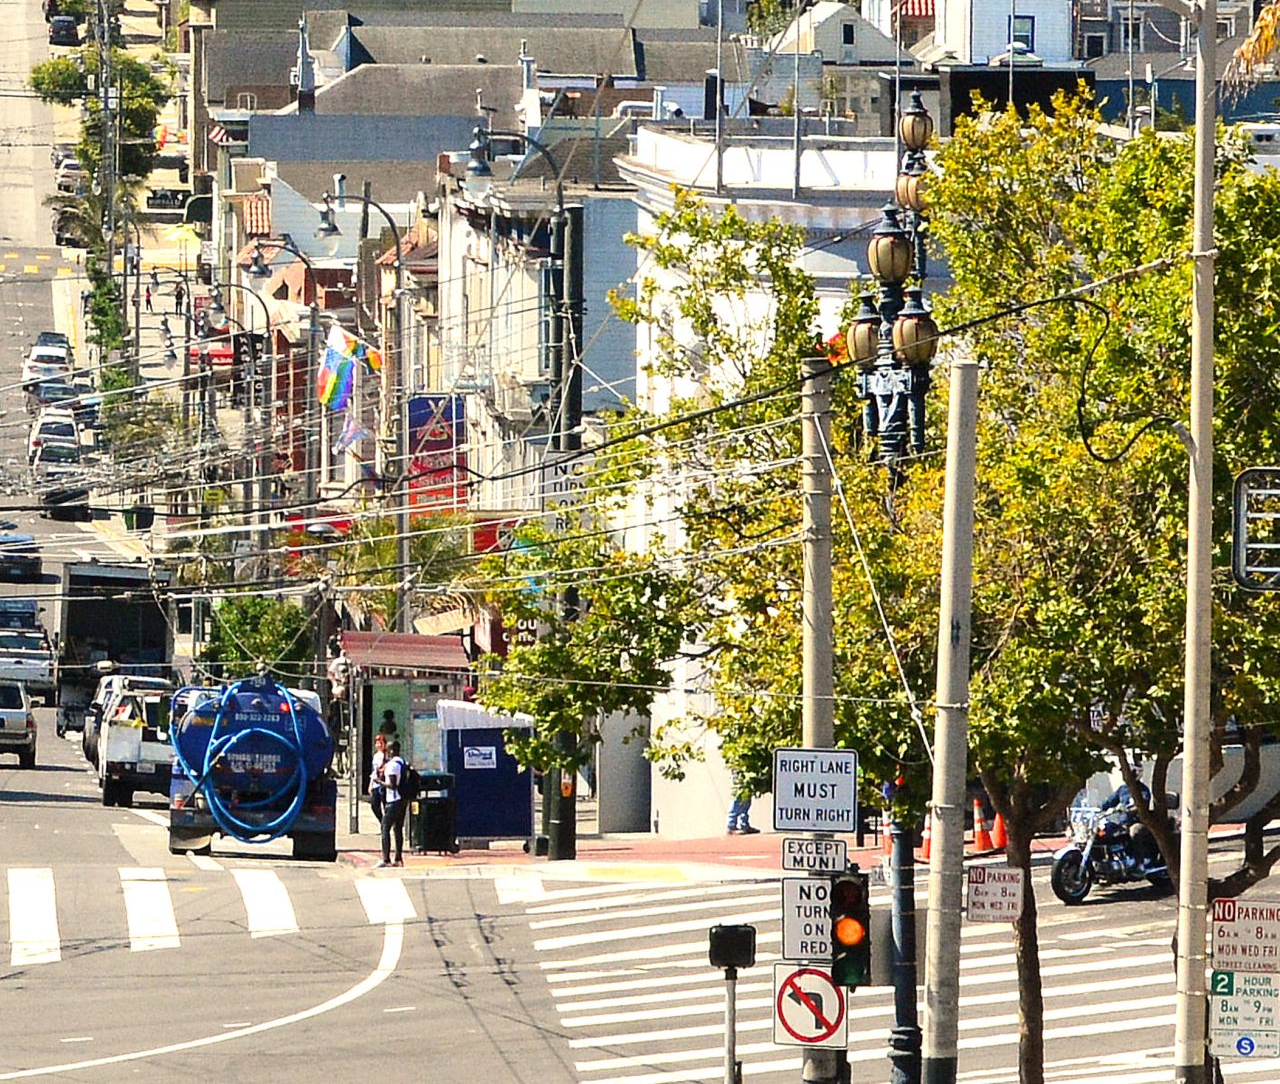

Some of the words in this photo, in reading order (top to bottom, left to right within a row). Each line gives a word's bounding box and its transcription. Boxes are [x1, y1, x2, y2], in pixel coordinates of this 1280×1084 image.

[780, 760, 815, 773] RIGHT
[821, 761, 852, 774] LANE
[794, 782, 837, 799] MUST
[778, 808, 811, 821] TURN
[816, 808, 851, 822] RIGHT
[788, 841, 840, 855] EXCEPT
[792, 855, 836, 869] MUNI
[969, 867, 984, 882] NO
[987, 872, 1021, 883] PARKING
[799, 885, 828, 901] NO
[795, 905, 831, 918] TURN
[1214, 901, 1234, 920] NO
[803, 923, 825, 936] ON
[800, 941, 828, 954] RED
[1217, 944, 1238, 956] MON
[1240, 945, 1260, 957] WED
[1263, 945, 1278, 957] FRI
[1216, 975, 1229, 992] 2
[1243, 976, 1272, 986] HOUR
[1235, 987, 1280, 997] PARKING
[1218, 1016, 1238, 1026] MON
[1260, 1017, 1274, 1027] FRI
[1240, 1039, 1252, 1054] S
